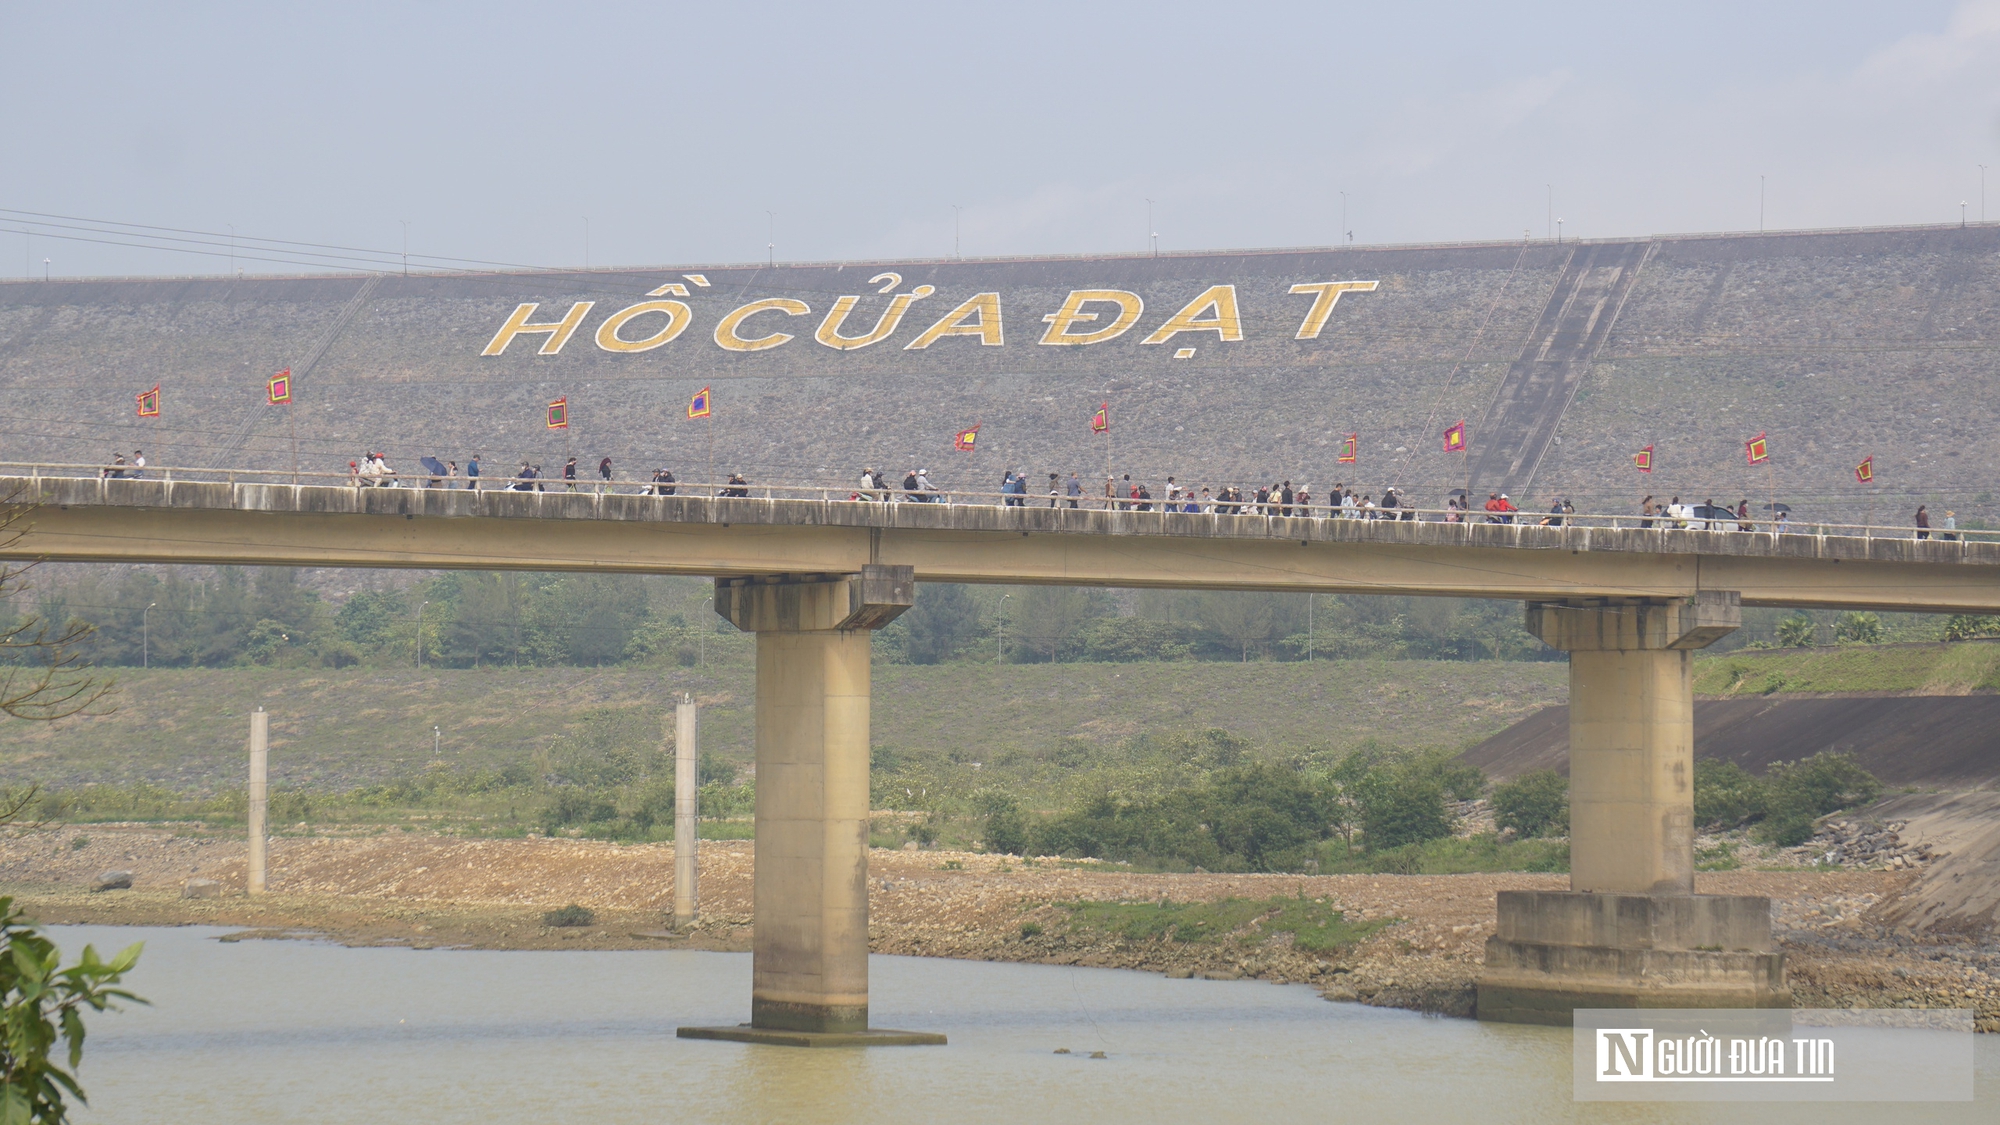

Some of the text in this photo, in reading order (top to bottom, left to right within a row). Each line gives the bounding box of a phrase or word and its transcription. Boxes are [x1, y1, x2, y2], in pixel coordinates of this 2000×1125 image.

[480, 272, 1380, 359] HỒ CỬA ĐẠT
